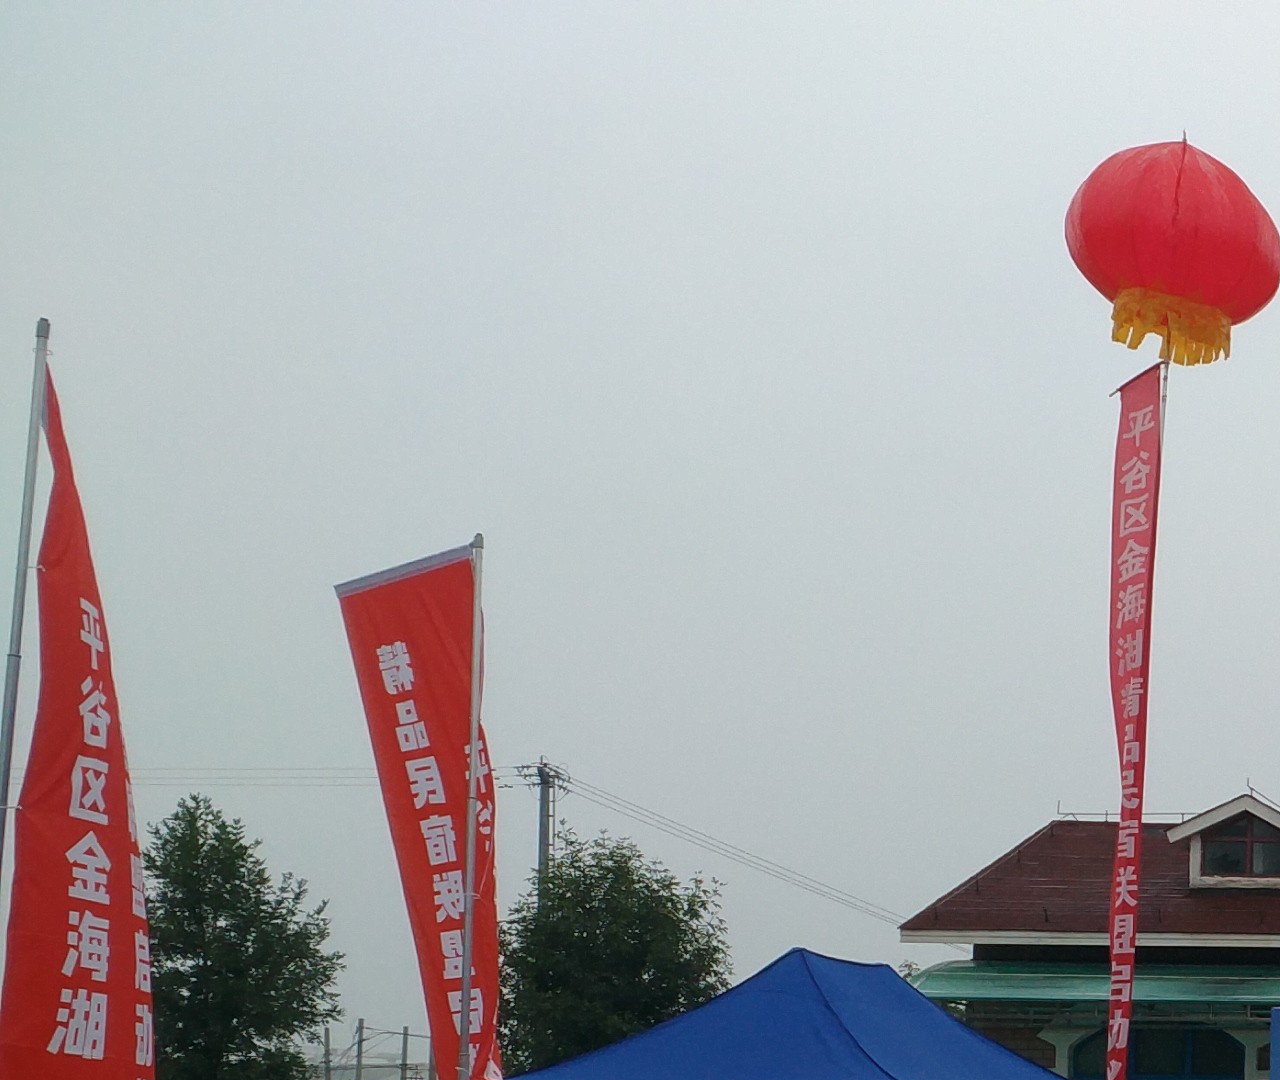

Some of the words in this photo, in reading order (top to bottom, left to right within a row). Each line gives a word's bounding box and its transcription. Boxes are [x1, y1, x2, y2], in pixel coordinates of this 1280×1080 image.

[47, 597, 111, 1061] 平谷区金海湖
